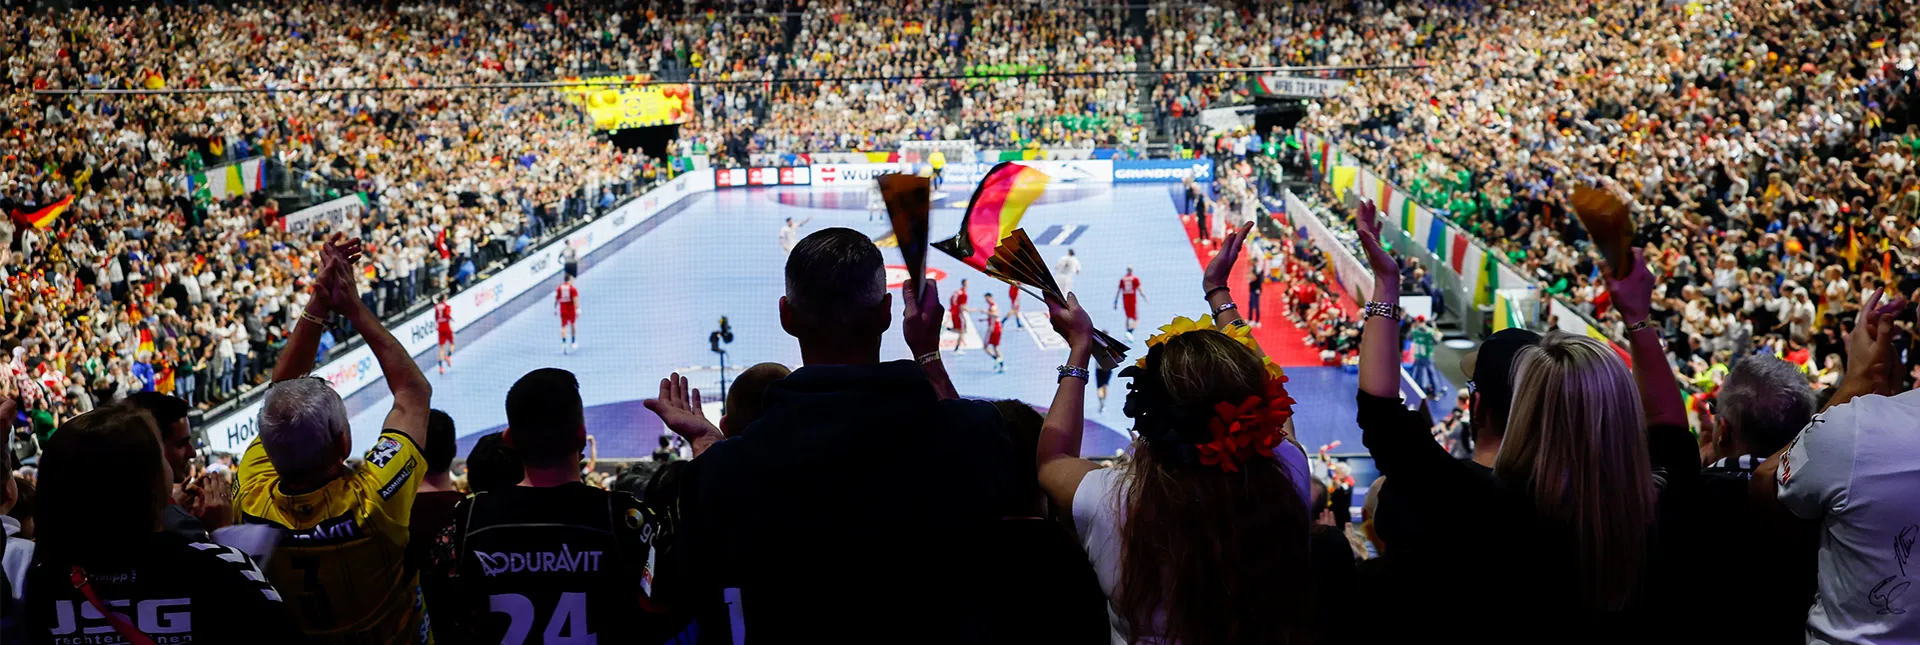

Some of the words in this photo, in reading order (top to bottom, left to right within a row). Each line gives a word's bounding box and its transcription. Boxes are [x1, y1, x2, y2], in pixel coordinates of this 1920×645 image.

[510, 543, 603, 573] DURAVIT
[48, 597, 192, 636] JSG
[488, 591, 598, 645] 24
